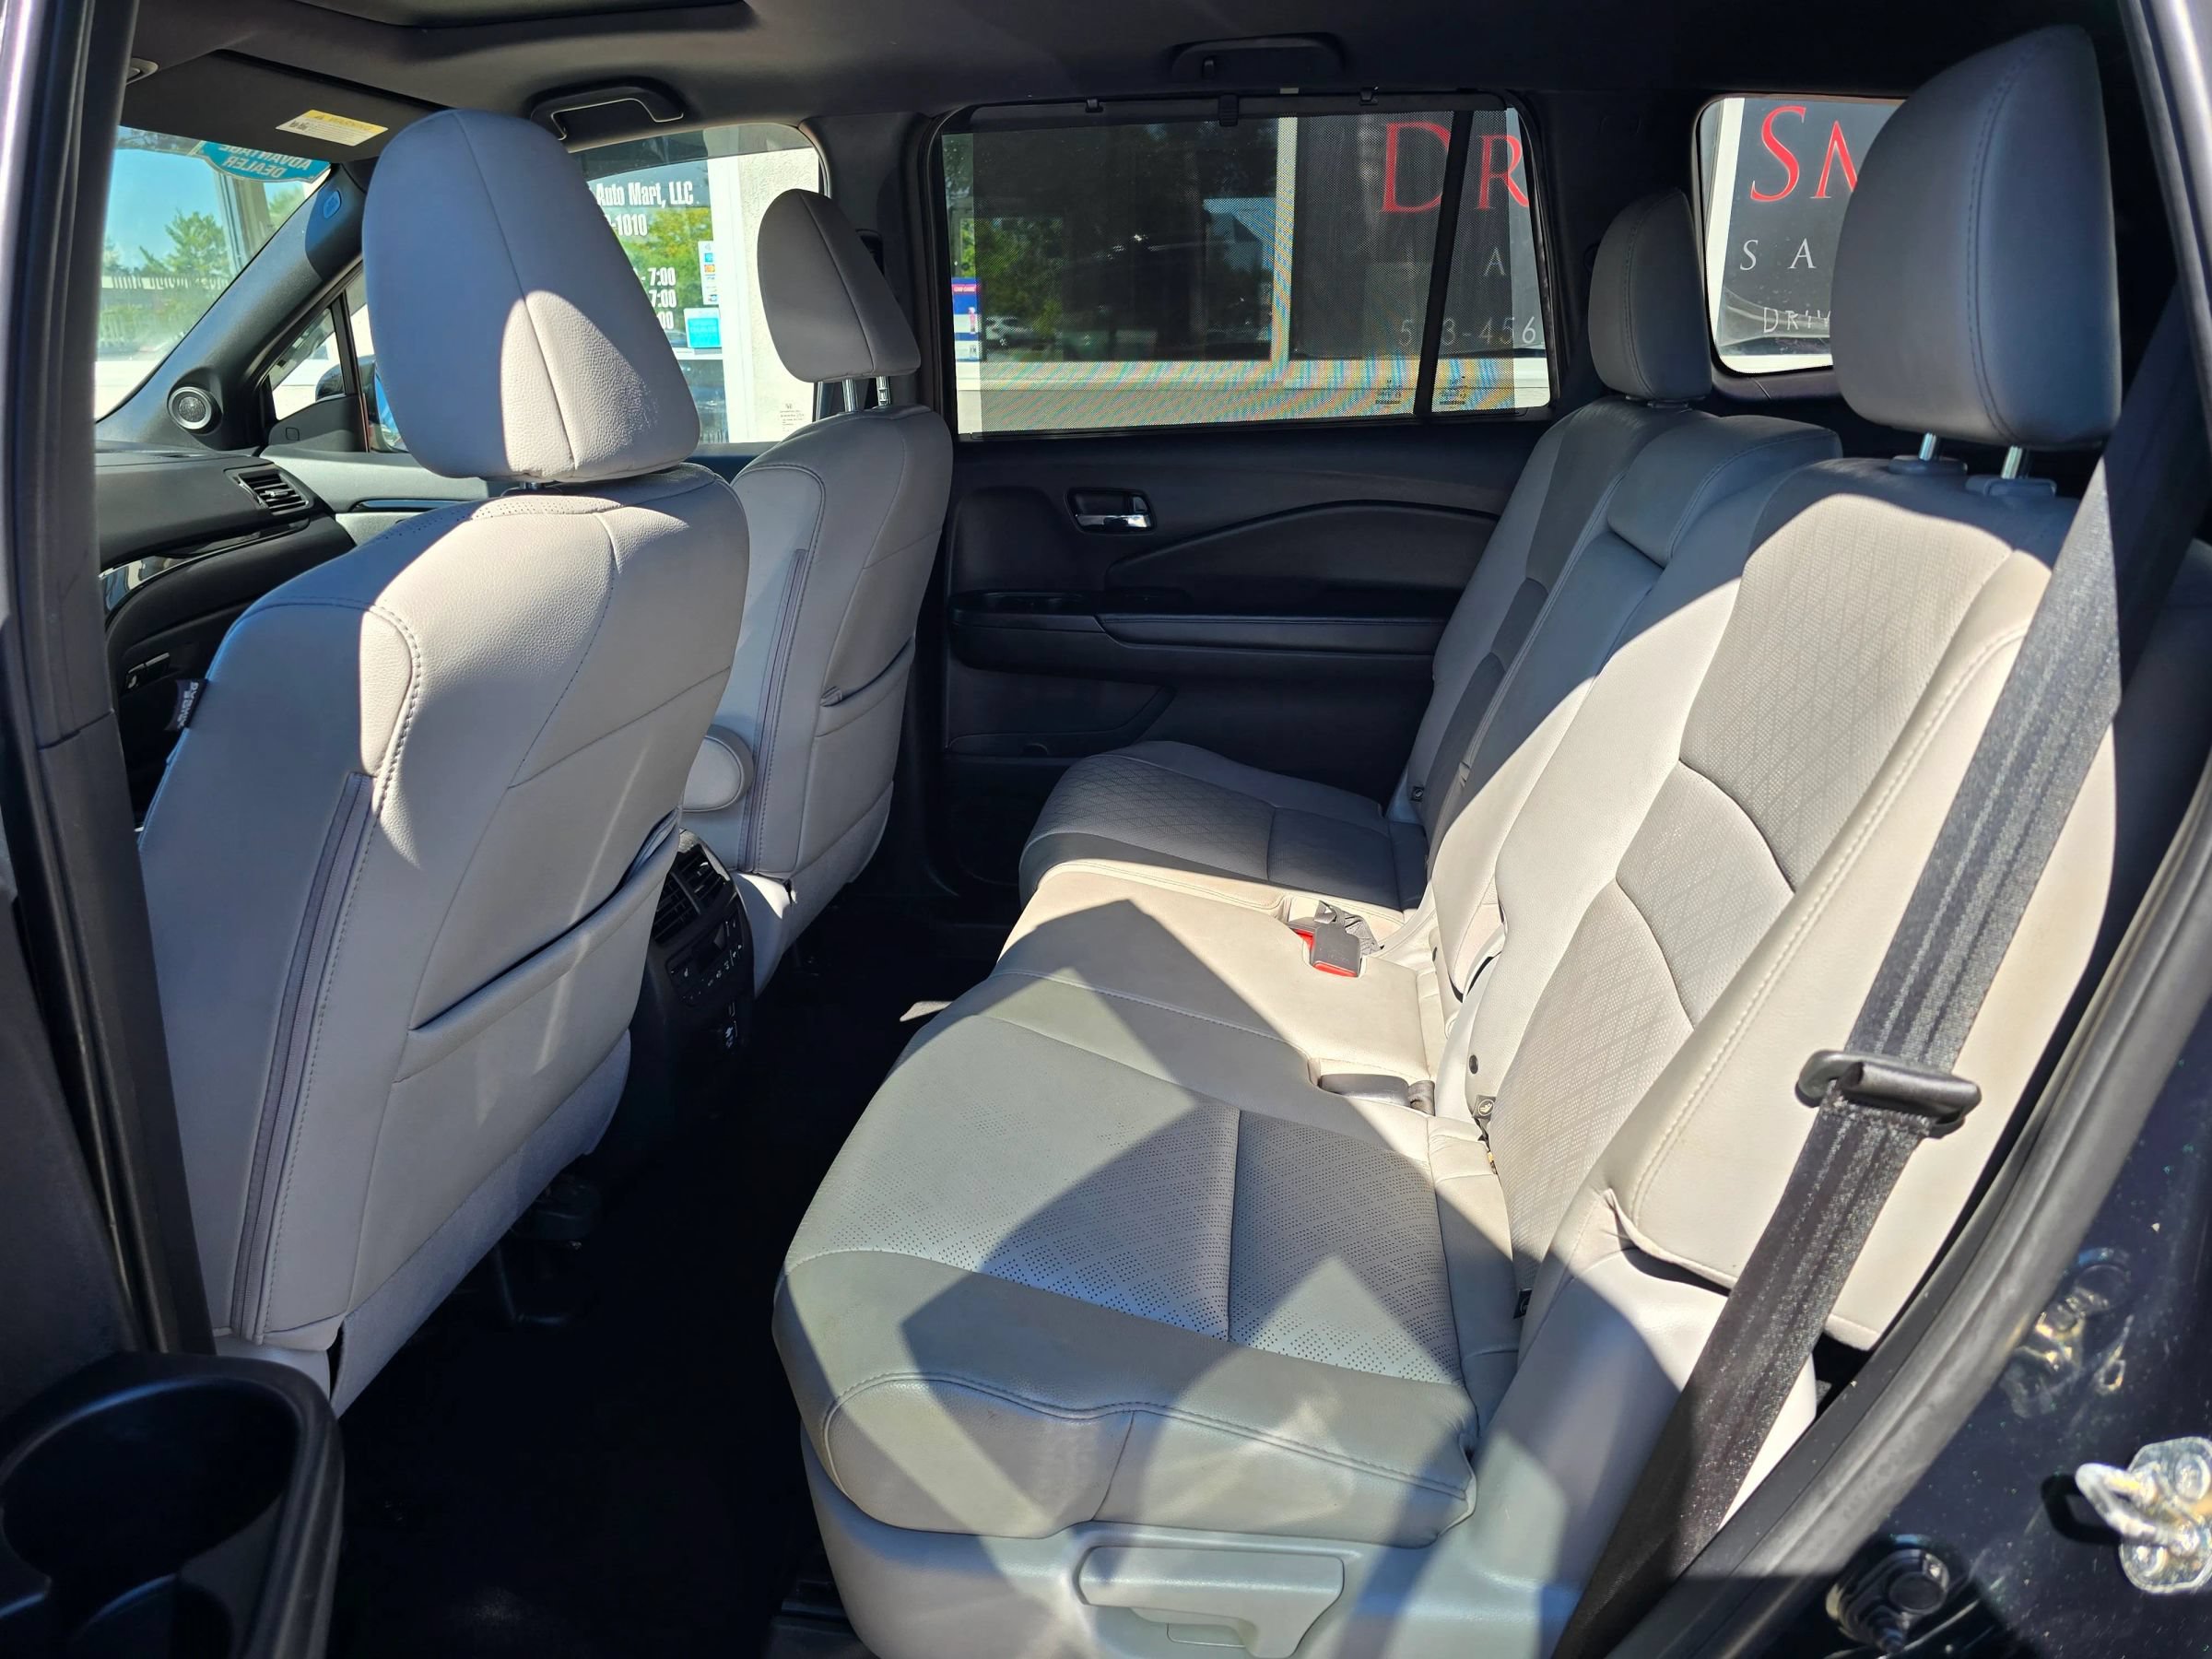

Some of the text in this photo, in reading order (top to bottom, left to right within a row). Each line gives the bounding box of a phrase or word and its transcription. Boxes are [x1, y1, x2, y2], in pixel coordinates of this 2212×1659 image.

[595, 182, 625, 206] Auto
[628, 182, 666, 208] Mart,
[648, 267, 677, 286] 7:00
[649, 289, 677, 308] 7:00
[1398, 316, 1536, 347] 53-456
